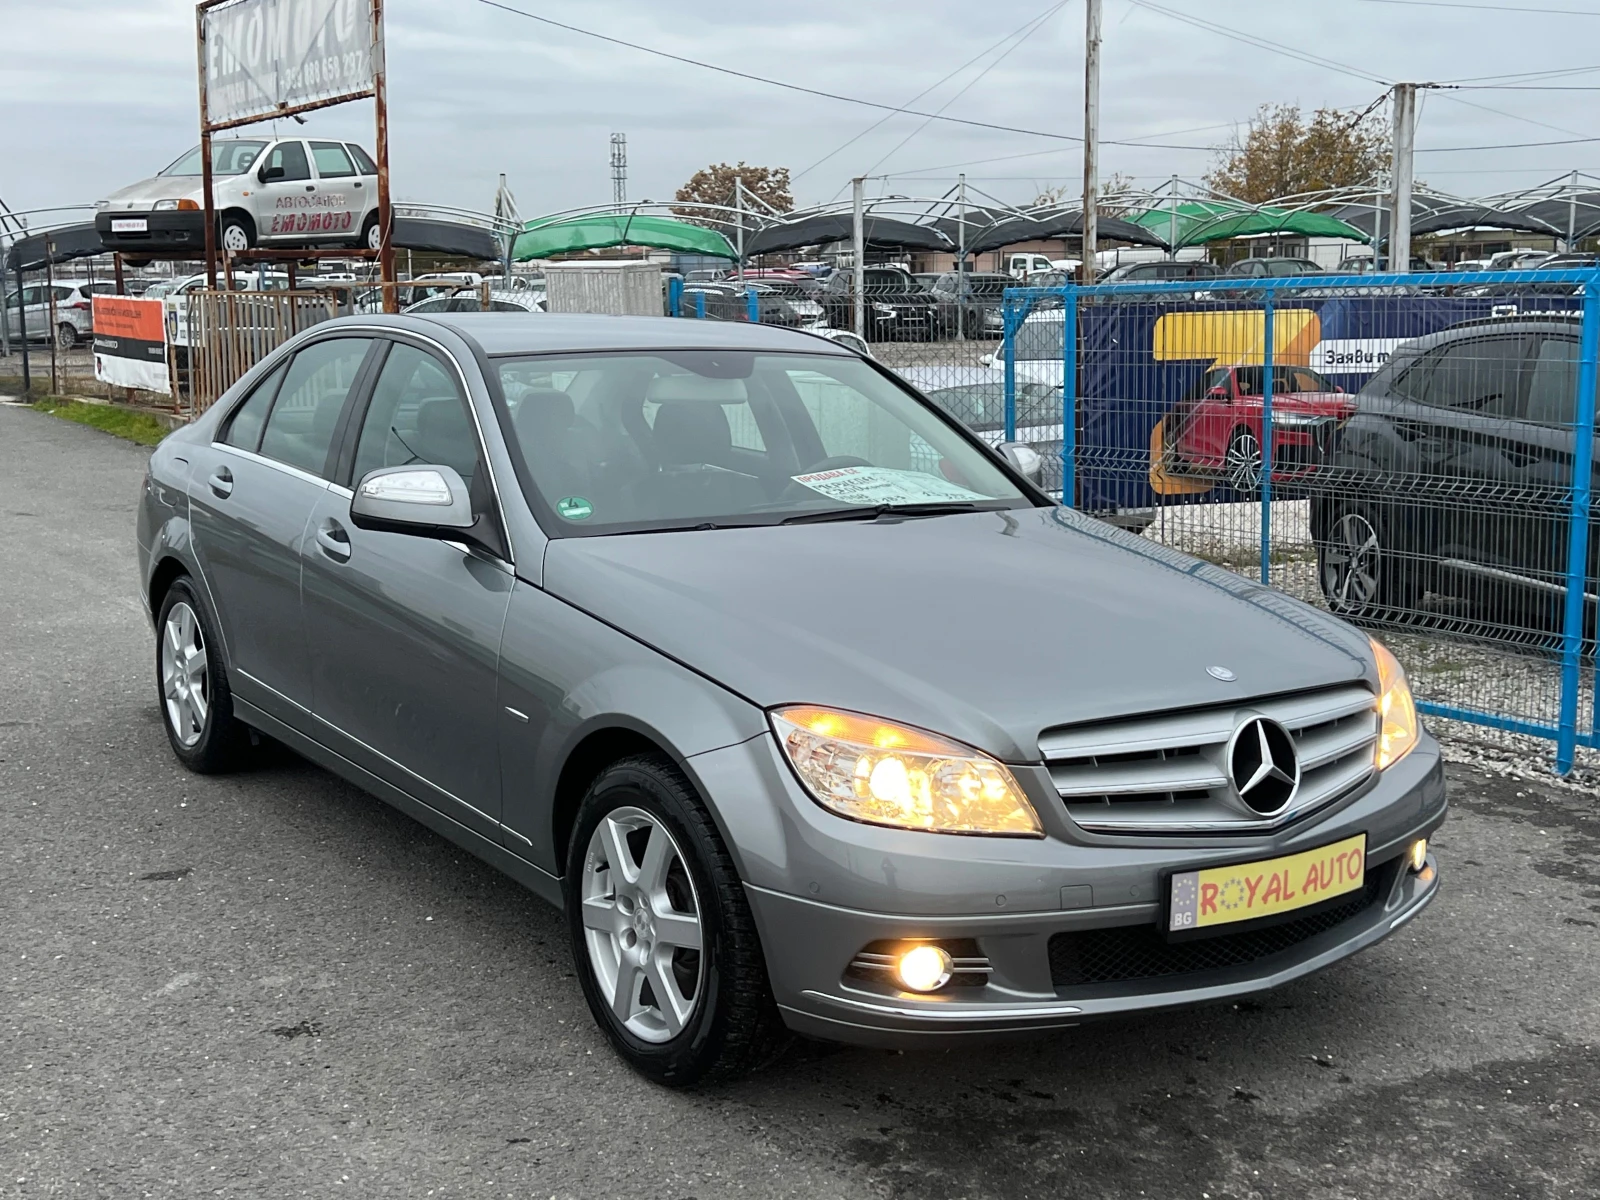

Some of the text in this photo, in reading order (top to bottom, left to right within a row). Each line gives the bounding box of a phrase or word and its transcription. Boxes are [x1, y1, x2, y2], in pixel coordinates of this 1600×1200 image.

[1325, 349, 1373, 364] Заяви
[797, 470, 843, 483] ПРОДАВА
[1302, 848, 1363, 895] AUTO
[1174, 912, 1192, 926] BG
